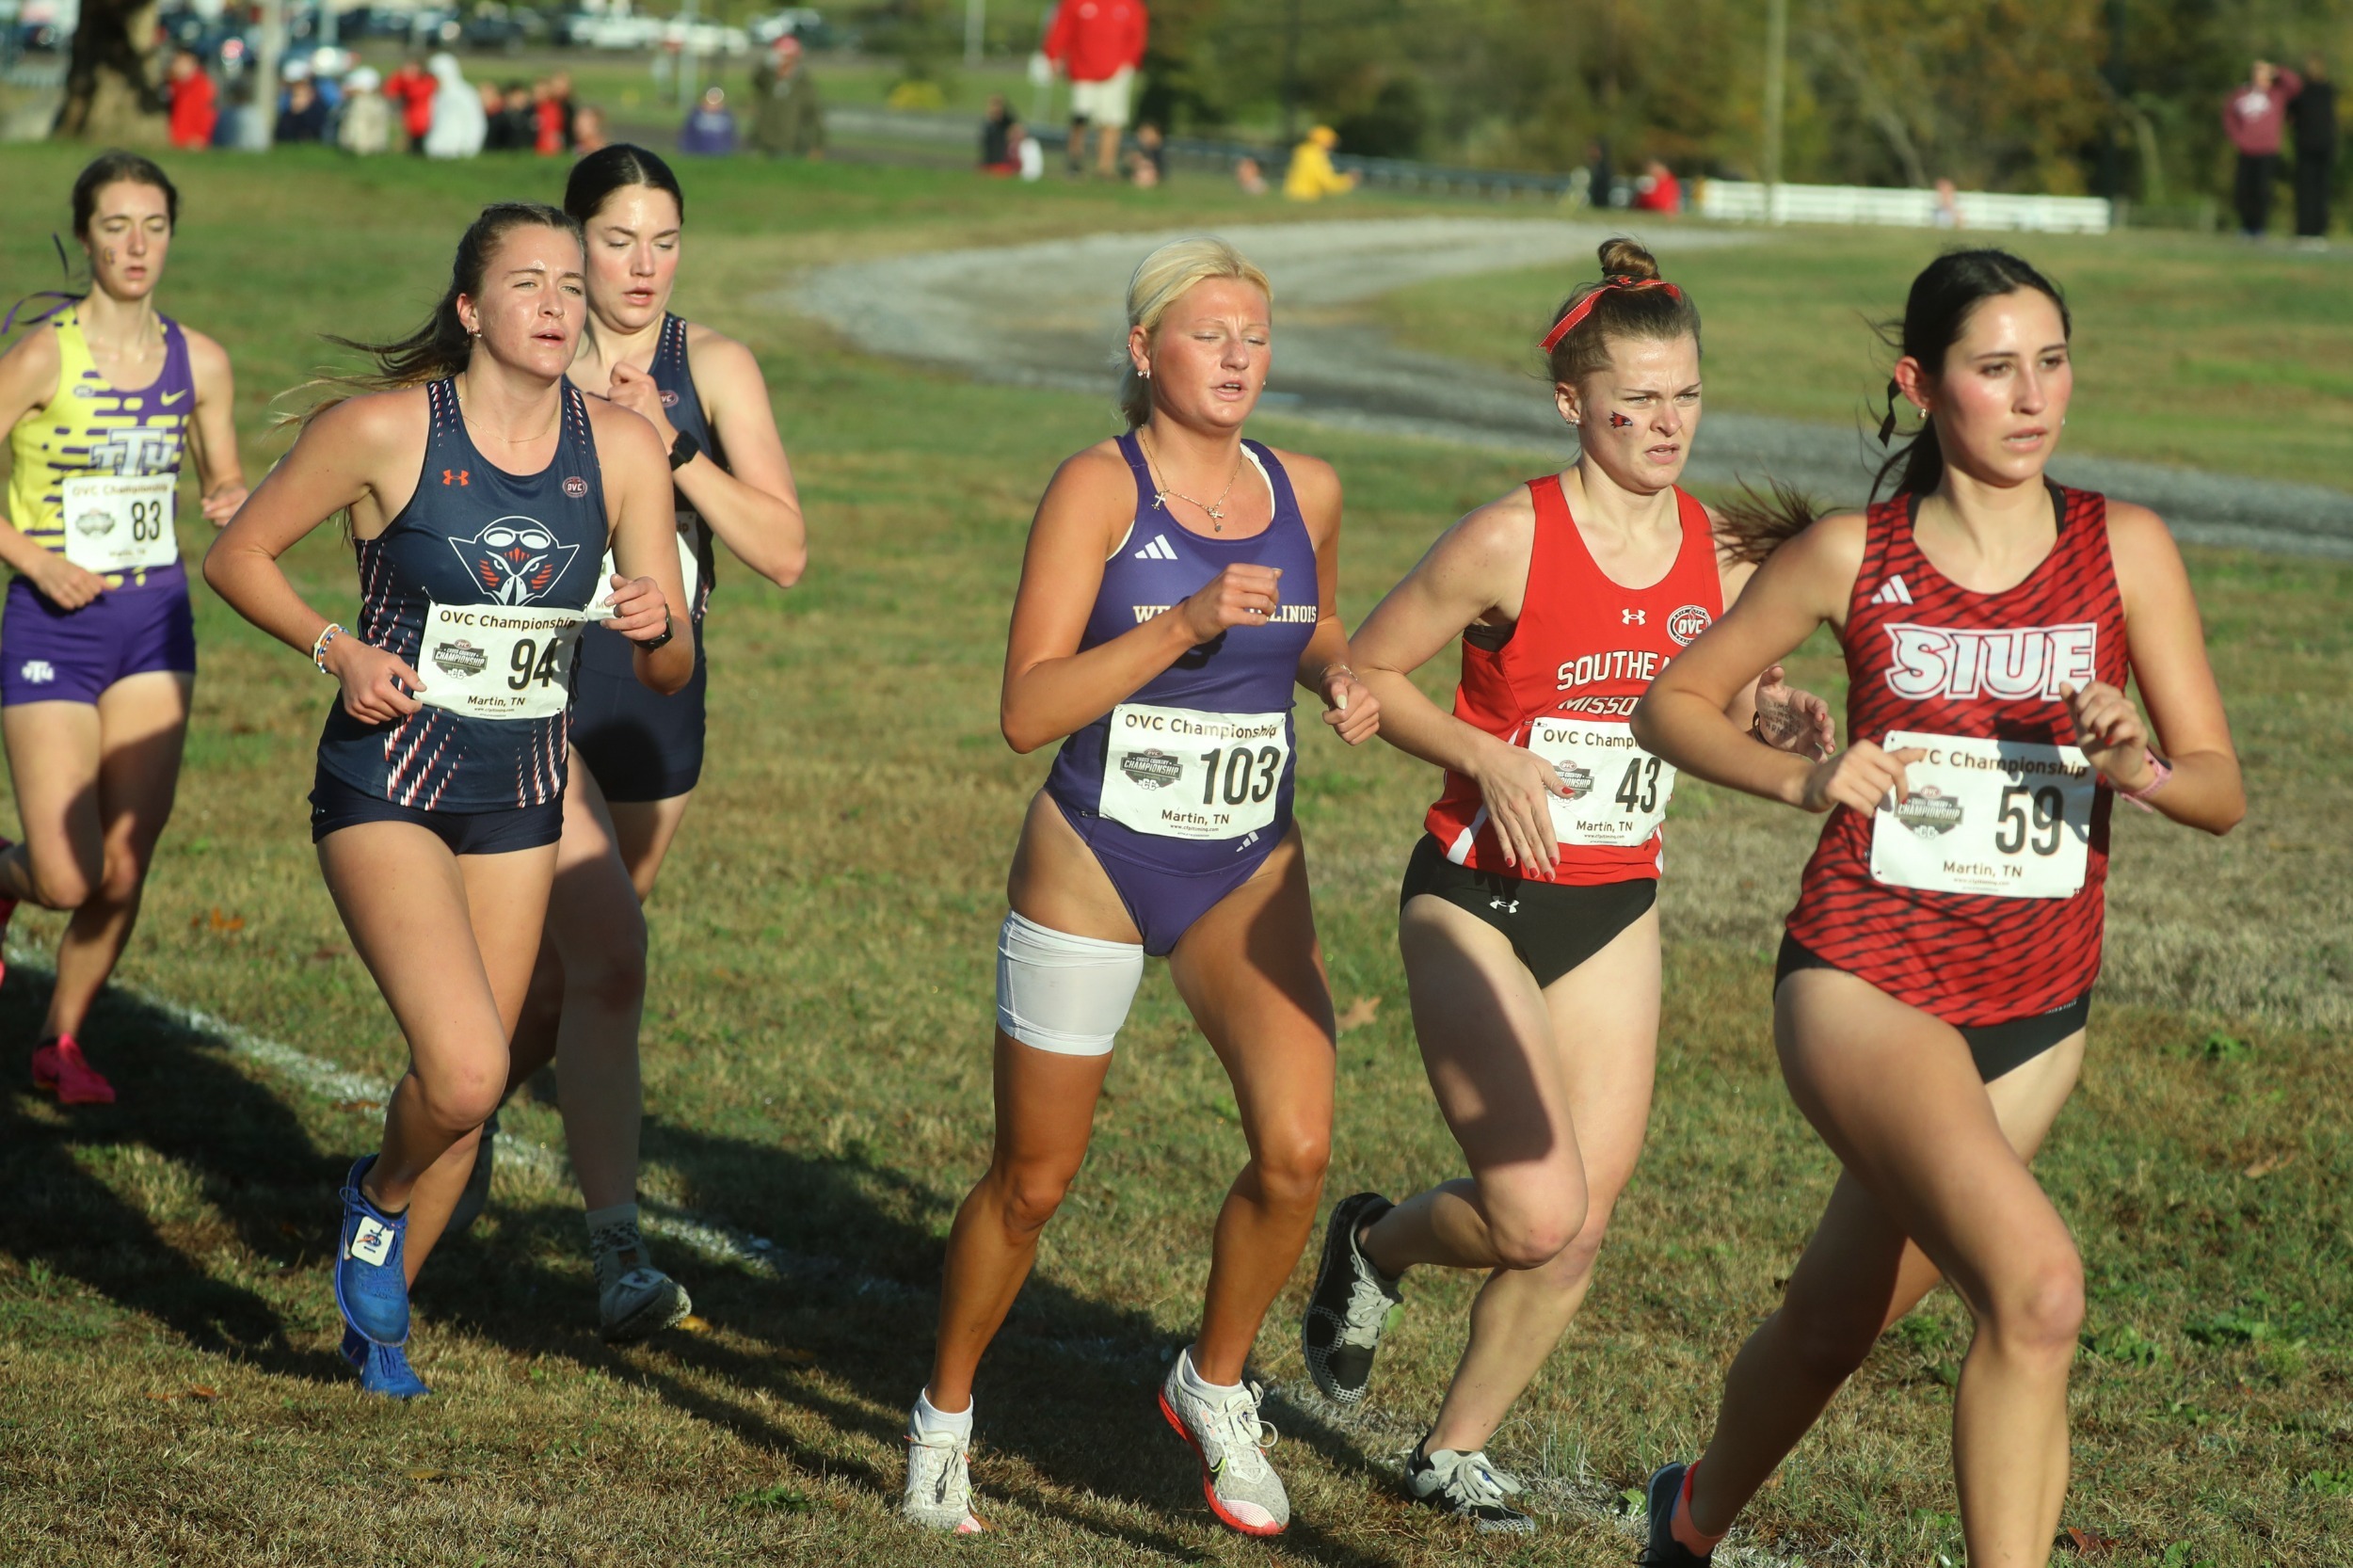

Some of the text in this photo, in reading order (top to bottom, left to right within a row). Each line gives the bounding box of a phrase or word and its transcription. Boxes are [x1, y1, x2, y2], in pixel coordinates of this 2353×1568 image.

[131, 501, 161, 542] 83
[440, 610, 576, 632] OVC Championship
[1678, 618, 1705, 634] OVC
[435, 650, 486, 667] CHAMPIONSHIP
[507, 637, 559, 691] 94
[1883, 622, 2098, 701] SIUE
[467, 695, 526, 707] Martin, TN
[1558, 696, 1641, 717] MISSO
[1125, 713, 1278, 741] OVC Championship
[1544, 728, 1579, 744] OVC
[1124, 760, 1180, 776] CHAMPIONSHIP
[1200, 745, 1281, 806] 103
[1950, 751, 2089, 779] Championship
[1615, 757, 1662, 814] 43
[1160, 808, 1230, 826] Martin, TN
[1897, 804, 1961, 821] CHAMPIONSHIP
[1994, 785, 2065, 857] 59
[1577, 820, 1633, 834] Martin, TN
[1943, 860, 2024, 878] Martin, TN
